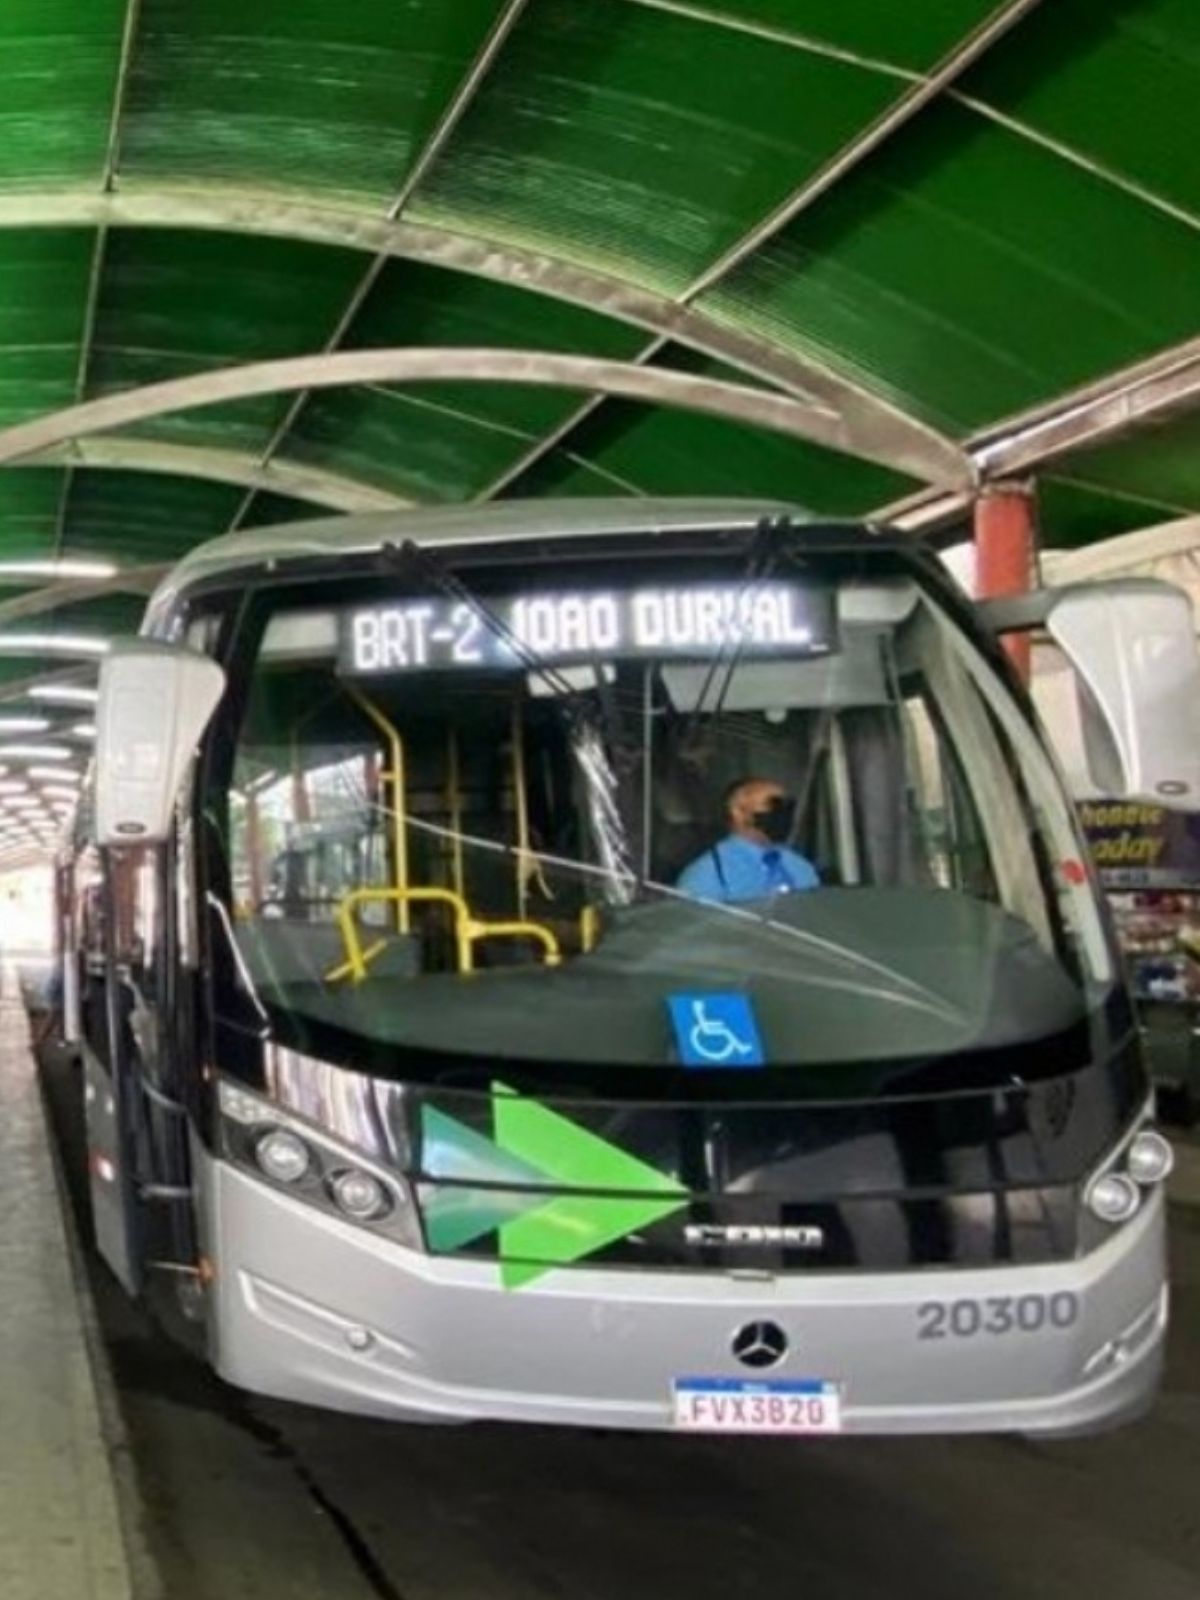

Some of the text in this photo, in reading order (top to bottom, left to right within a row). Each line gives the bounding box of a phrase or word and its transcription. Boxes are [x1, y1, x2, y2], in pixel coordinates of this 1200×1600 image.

[353, 588, 810, 669] BRT-2 JOAO DURVAL
[916, 1291, 1079, 1341] 20300
[691, 1397, 825, 1426] FVX3B20
